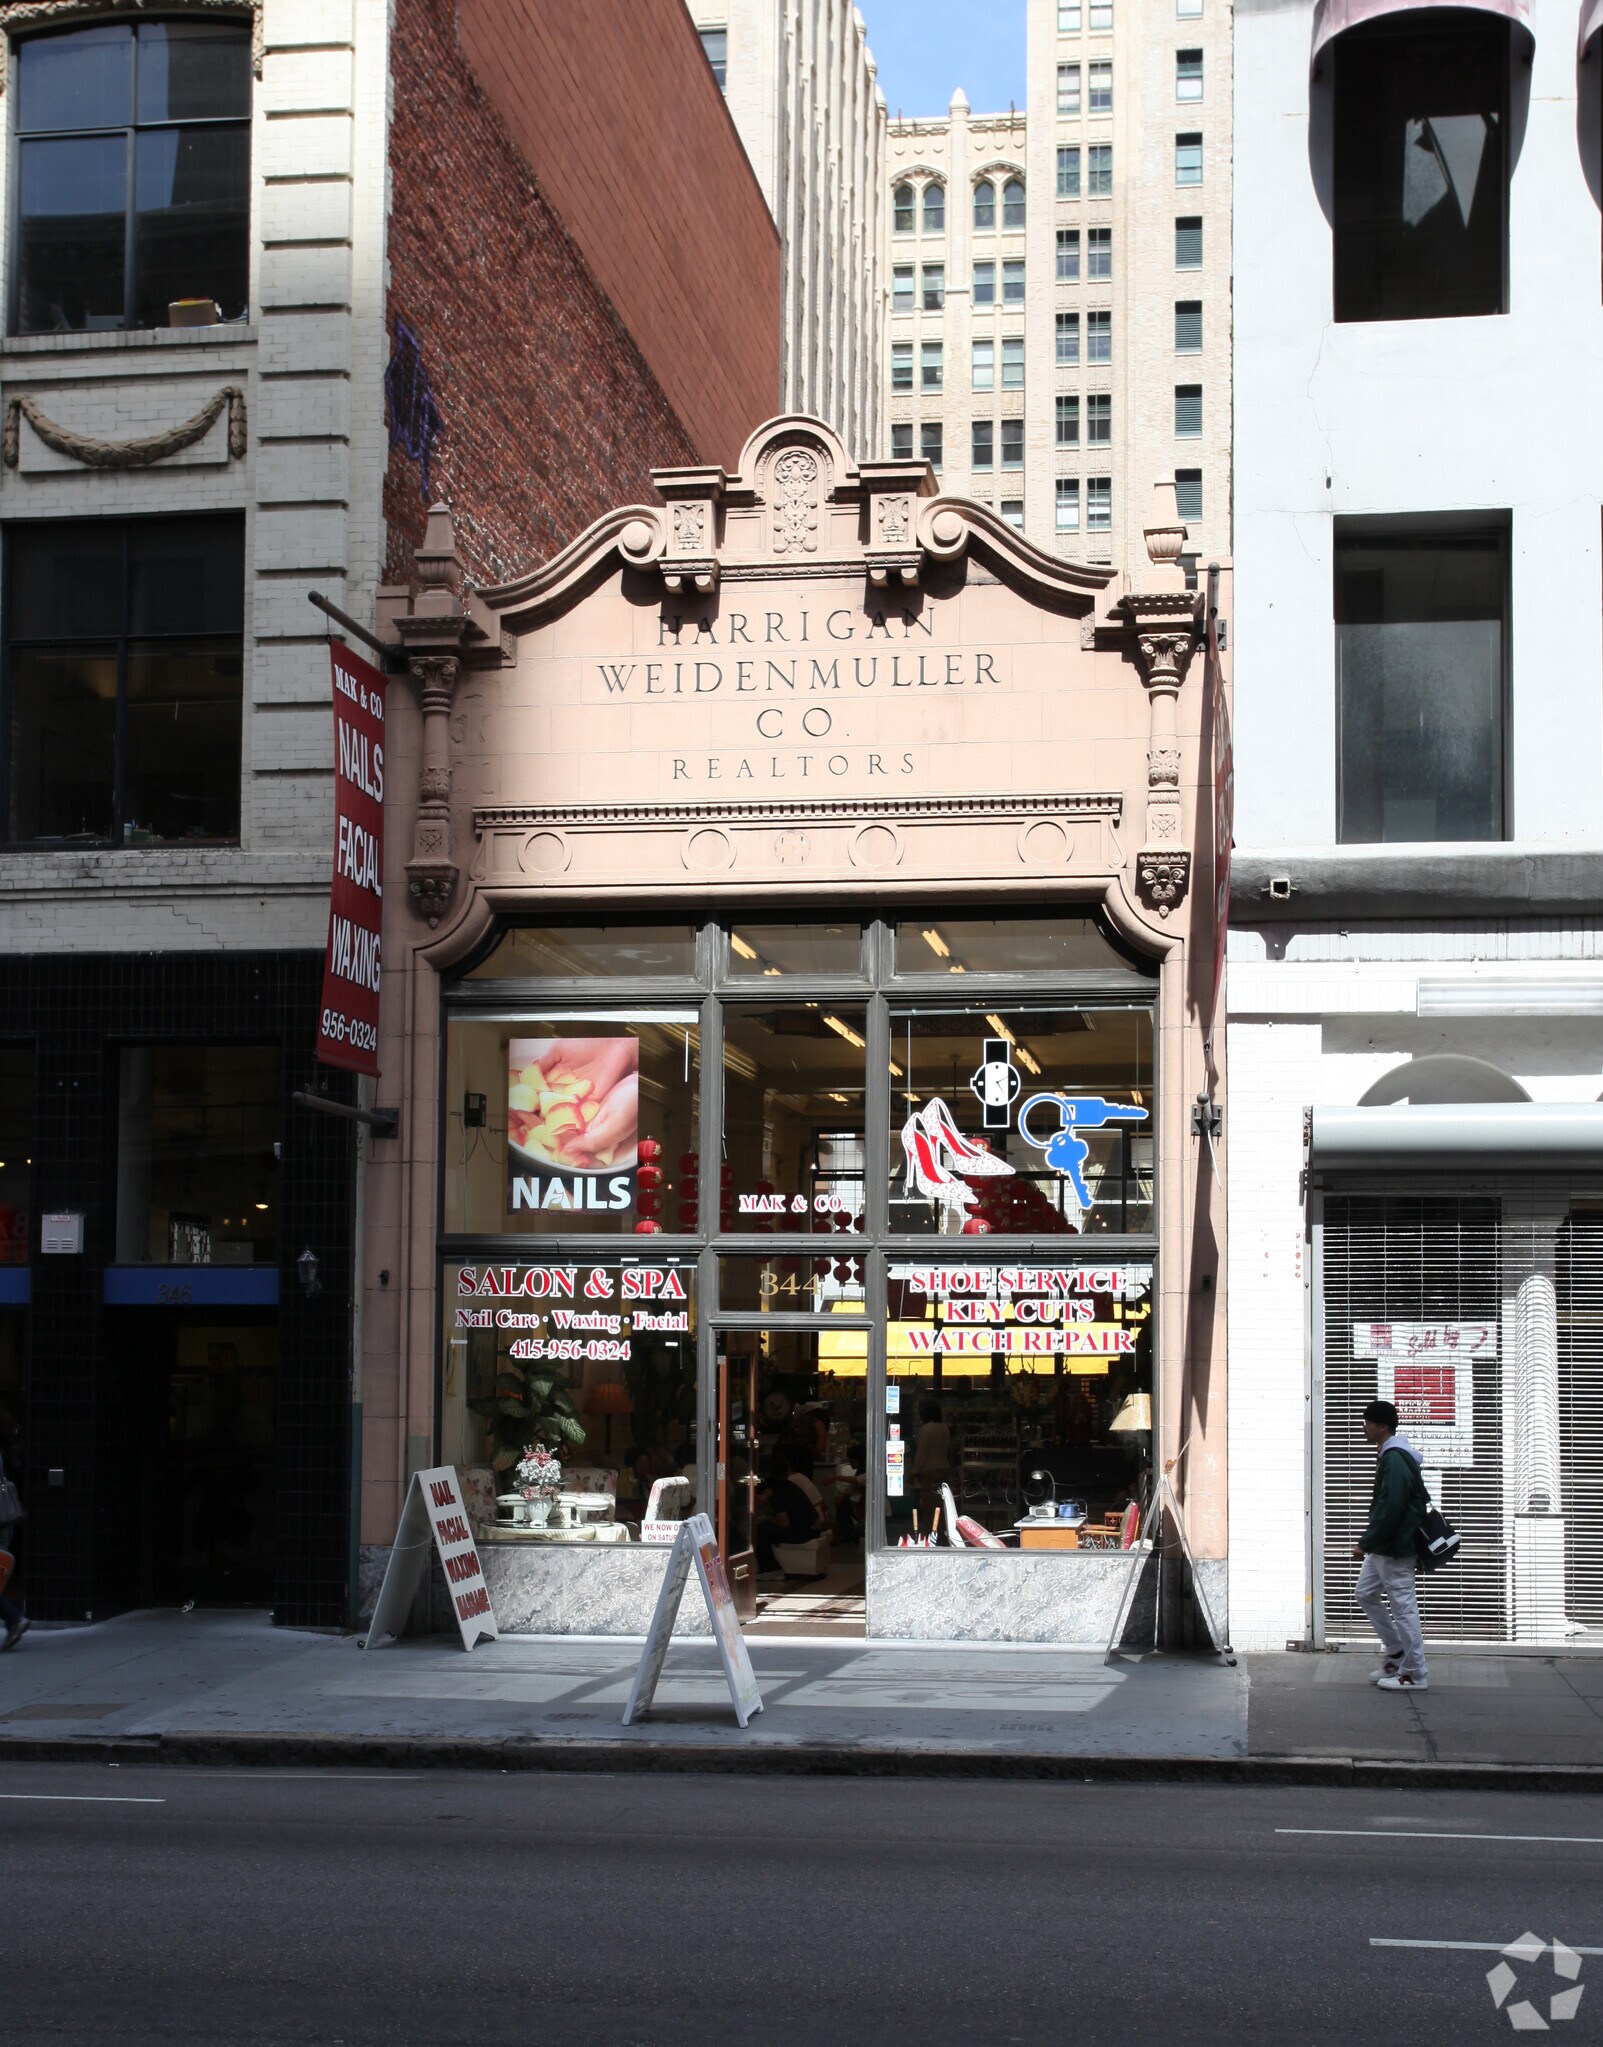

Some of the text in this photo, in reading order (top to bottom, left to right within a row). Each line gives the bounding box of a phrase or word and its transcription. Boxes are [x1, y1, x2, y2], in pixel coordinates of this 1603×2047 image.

[657, 607, 935, 647] HARRIGAN
[596, 653, 1001, 694] WEIDENMULLER
[334, 664, 384, 722] MAK & CO.
[338, 717, 384, 803] NAILS
[672, 753, 914, 780] REALTORS
[337, 814, 382, 897] FACIAL
[331, 913, 381, 993] WAXING
[321, 1008, 376, 1051] 956-0324
[512, 1176, 631, 1209] NAILS
[739, 1194, 848, 1213] MAK & CO.
[156, 1282, 193, 1304] 346
[458, 1267, 686, 1299] SALON & SPA
[759, 1272, 819, 1295] 344
[909, 1270, 1129, 1293] SHOE SERVICE
[456, 1309, 688, 1334] Nail Care Waxing Facial
[943, 1299, 1095, 1323] KEY CUTS
[510, 1339, 631, 1361] 415-956-0324
[907, 1329, 1135, 1353] WATCH REPAIR
[430, 1480, 456, 1508] NAIL
[436, 1515, 469, 1546] FACIAL
[445, 1551, 480, 1584] WAXING
